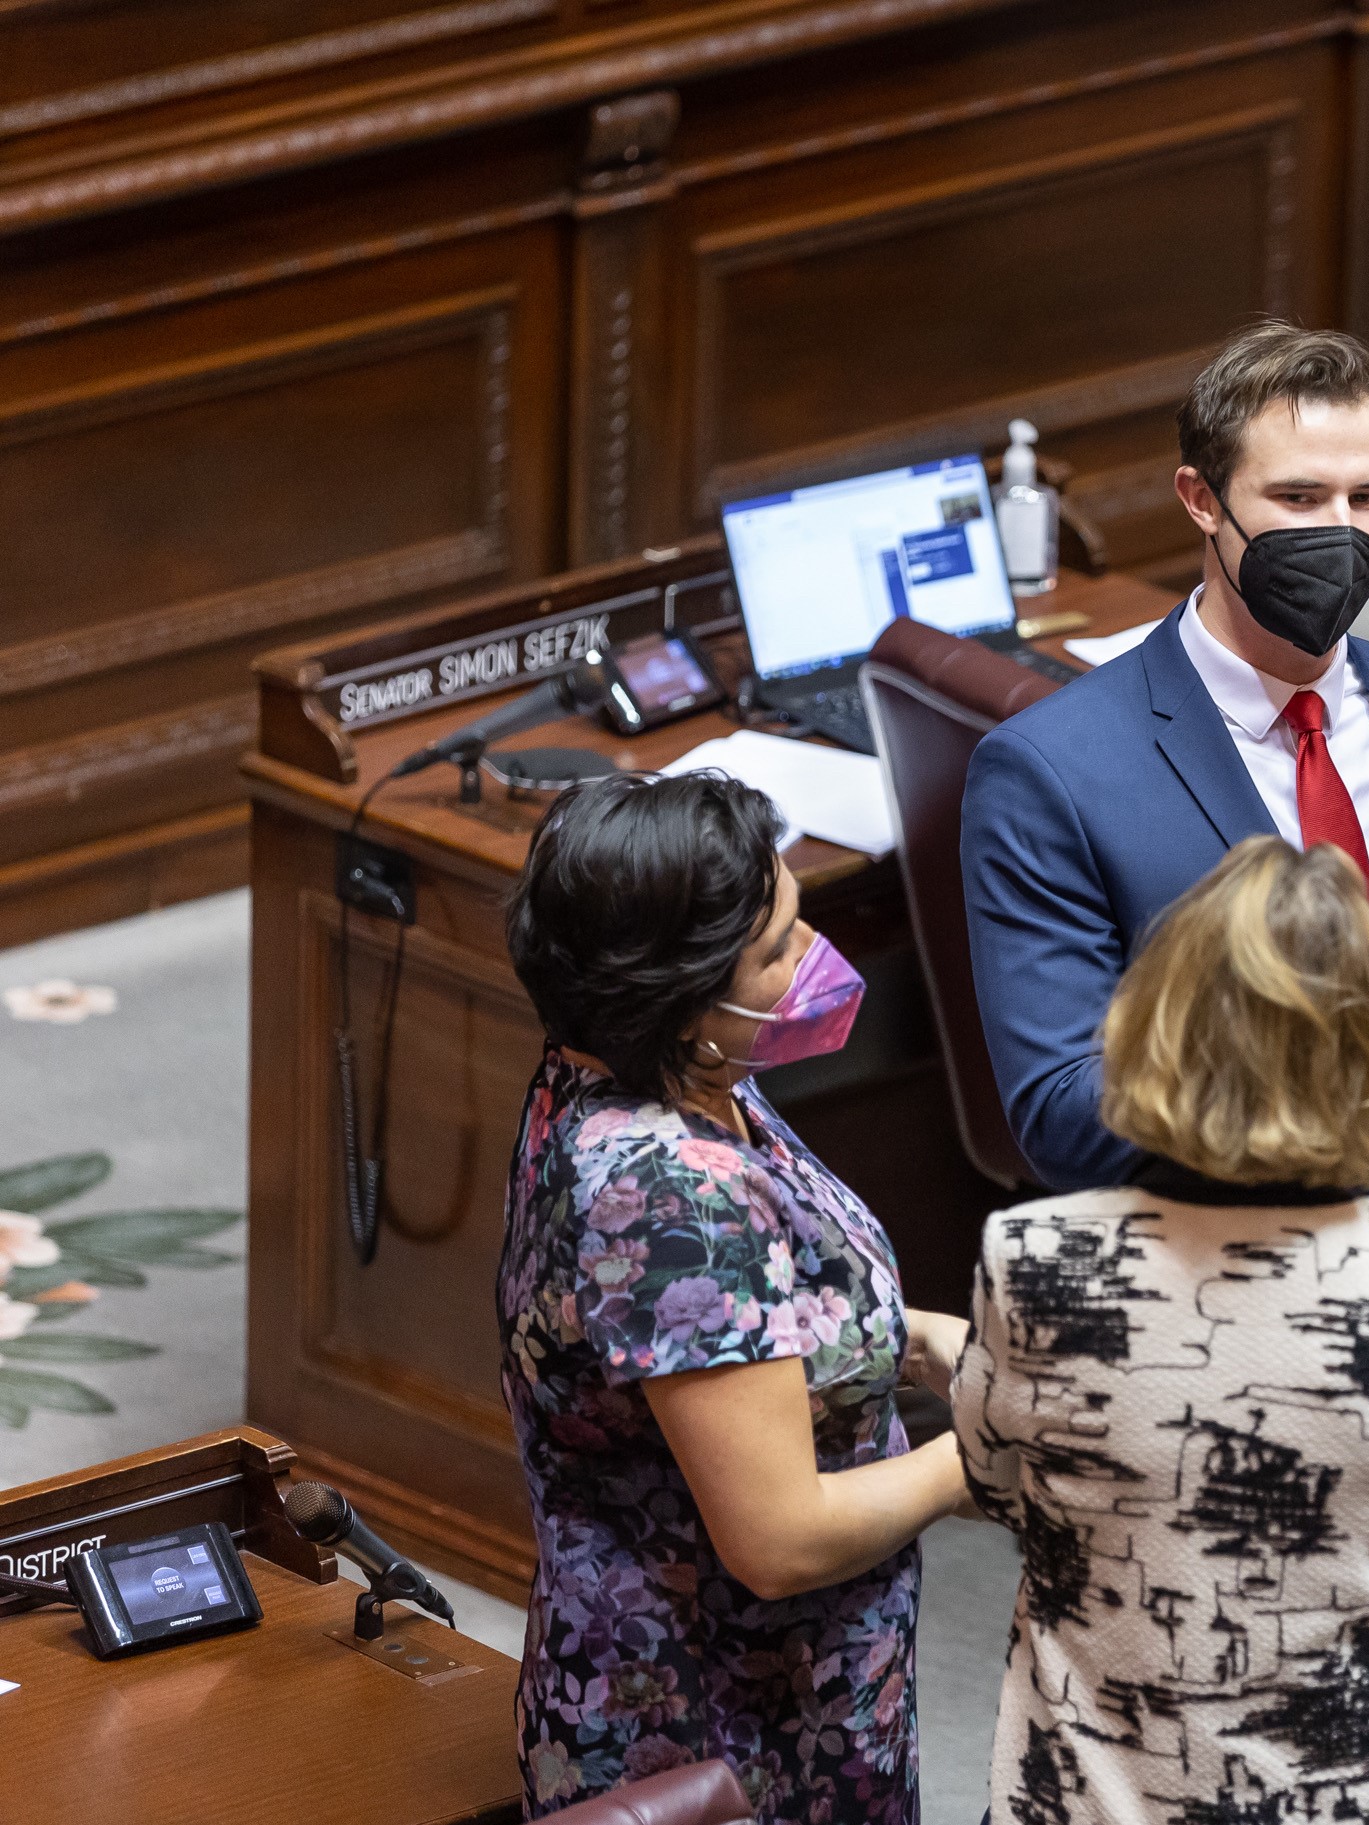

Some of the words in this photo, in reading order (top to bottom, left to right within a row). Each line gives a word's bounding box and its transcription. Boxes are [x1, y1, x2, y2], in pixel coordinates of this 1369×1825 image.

[340, 668, 433, 722] SENATOR
[438, 637, 518, 695] SIMON
[523, 613, 611, 672] SEFZIK
[154, 1575, 180, 1586] REQUEST
[165, 1582, 185, 1592] SPEAK
[169, 1615, 203, 1627] CRESTRON
